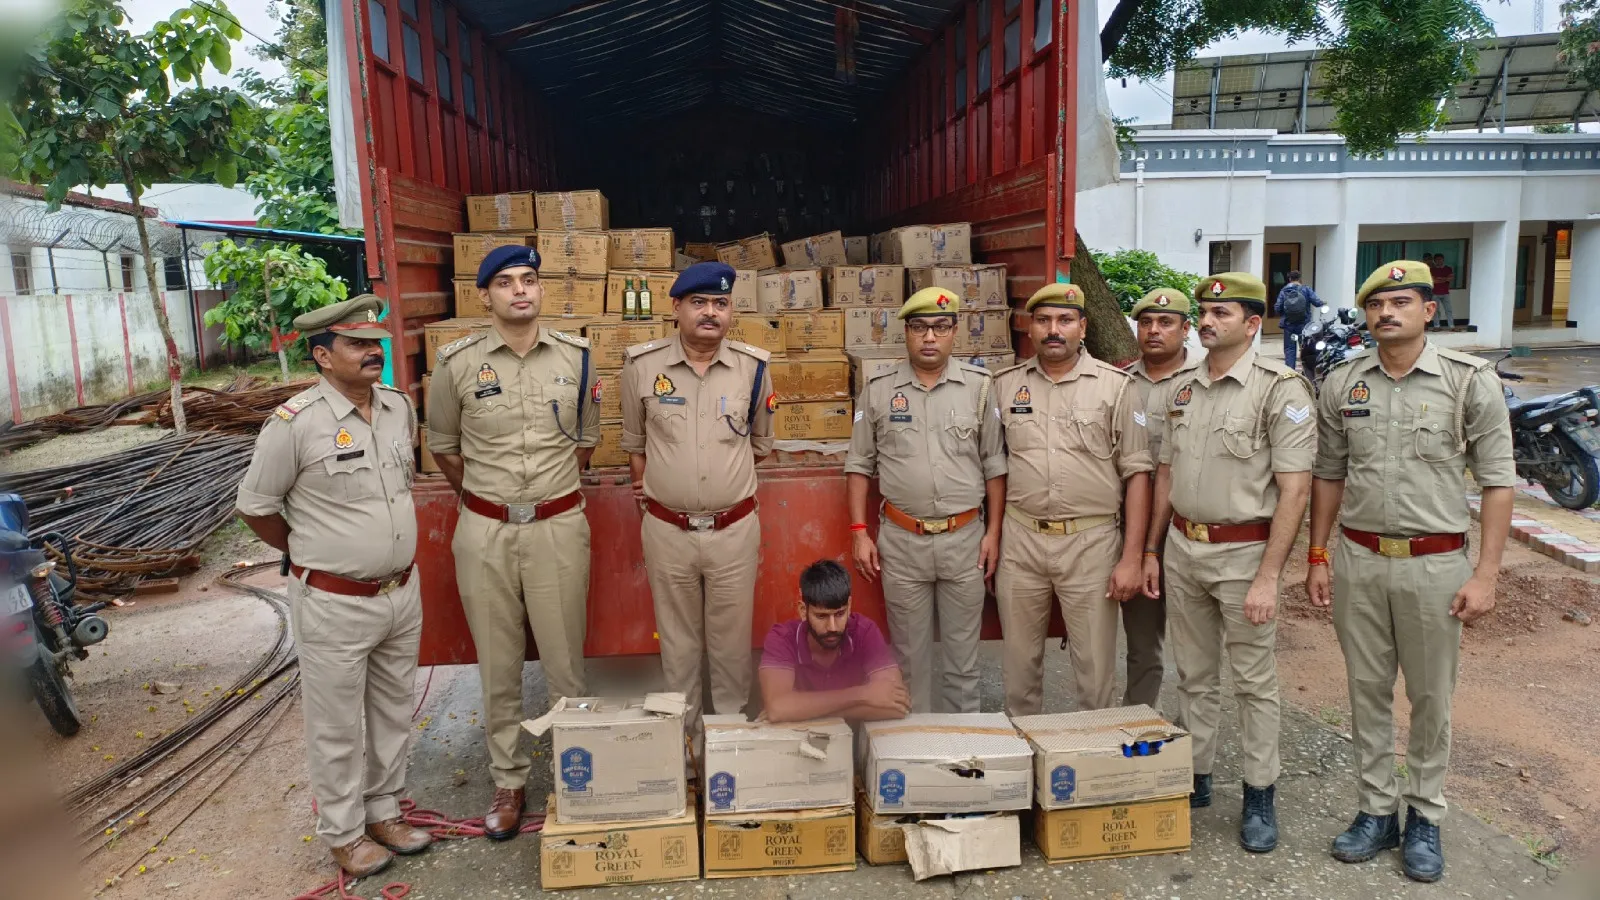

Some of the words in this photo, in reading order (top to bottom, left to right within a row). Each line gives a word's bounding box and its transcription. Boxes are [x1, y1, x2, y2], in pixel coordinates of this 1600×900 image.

[1102, 820, 1138, 832] ROYAL
[765, 835, 803, 846] ROYAL
[1102, 831, 1138, 843] GREEN
[595, 848, 643, 860] ROYAL
[765, 846, 803, 857] GREEN
[595, 859, 643, 872] GREEN
[605, 874, 634, 882] WHISKY
